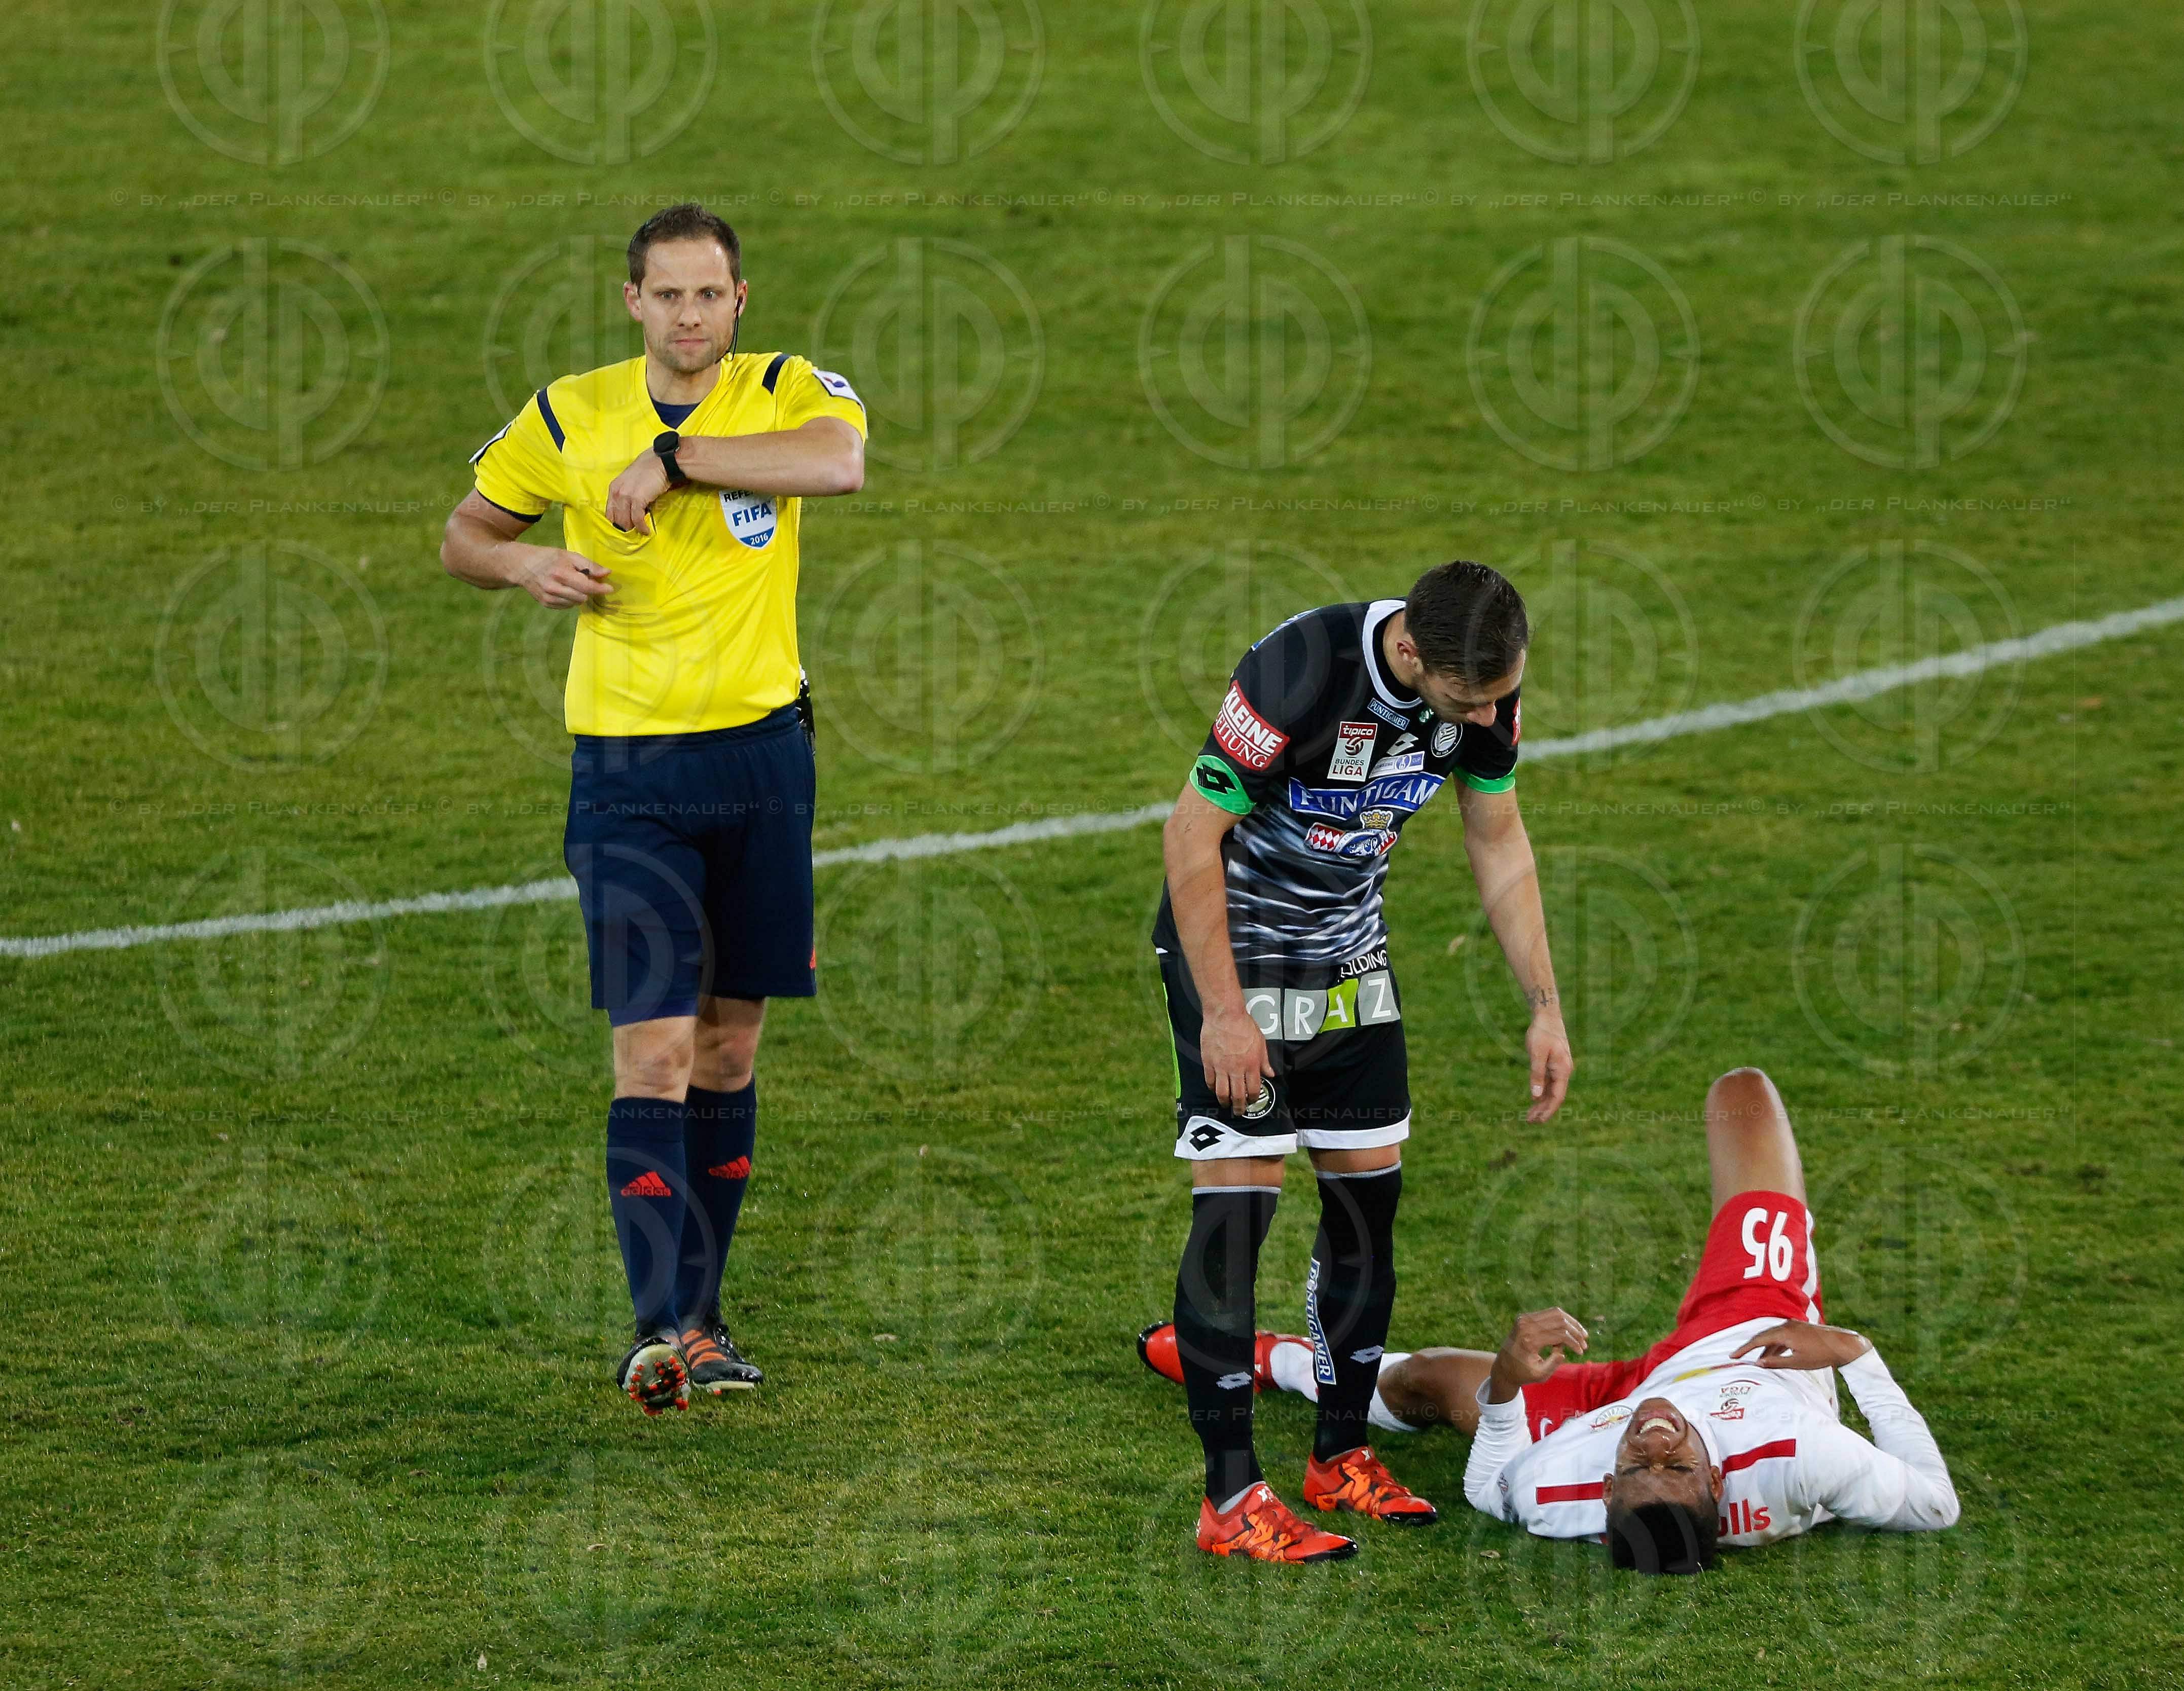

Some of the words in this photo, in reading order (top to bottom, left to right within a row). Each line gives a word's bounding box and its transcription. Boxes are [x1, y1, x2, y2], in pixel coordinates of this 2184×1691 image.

[723, 490, 753, 502] REFE
[732, 502, 772, 527] FIFA
[750, 533, 769, 545] 2016
[1224, 685, 1284, 754] KLEINE
[1370, 700, 1407, 727] PUNTIGAMER
[1343, 725, 1374, 736] tipico
[1332, 765, 1363, 776] LIGA
[1341, 950, 1387, 978] OLDING
[1246, 978, 1391, 1035] GRAZ
[621, 1185, 671, 1196] adidas
[1742, 1207, 1793, 1281] 95
